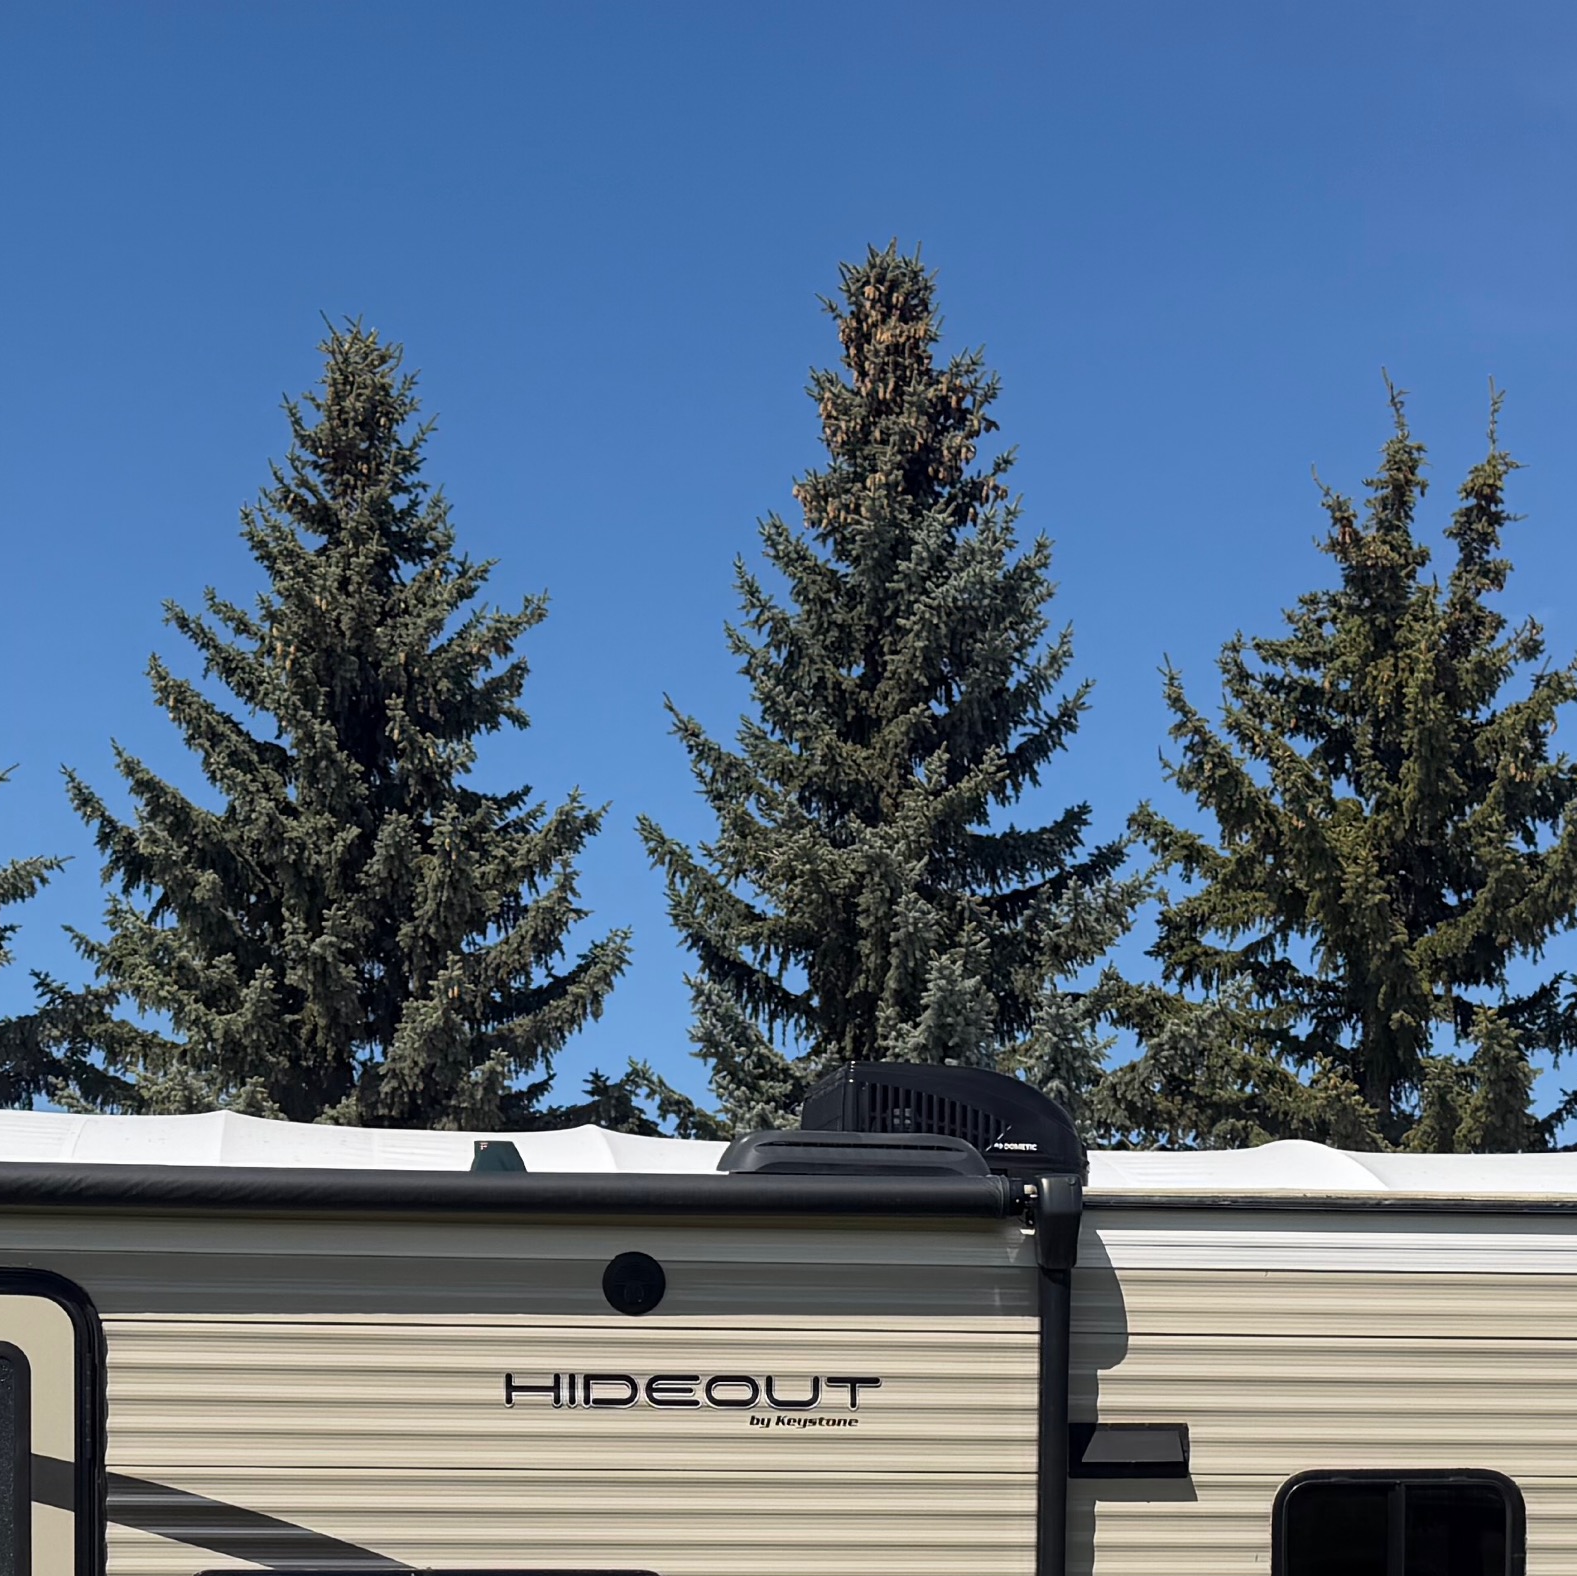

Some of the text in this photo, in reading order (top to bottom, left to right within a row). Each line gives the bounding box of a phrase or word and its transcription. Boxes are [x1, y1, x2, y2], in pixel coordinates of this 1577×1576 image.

[504, 1371, 882, 1410] HIDEOUT
[749, 1415, 859, 1429] by Keystone
